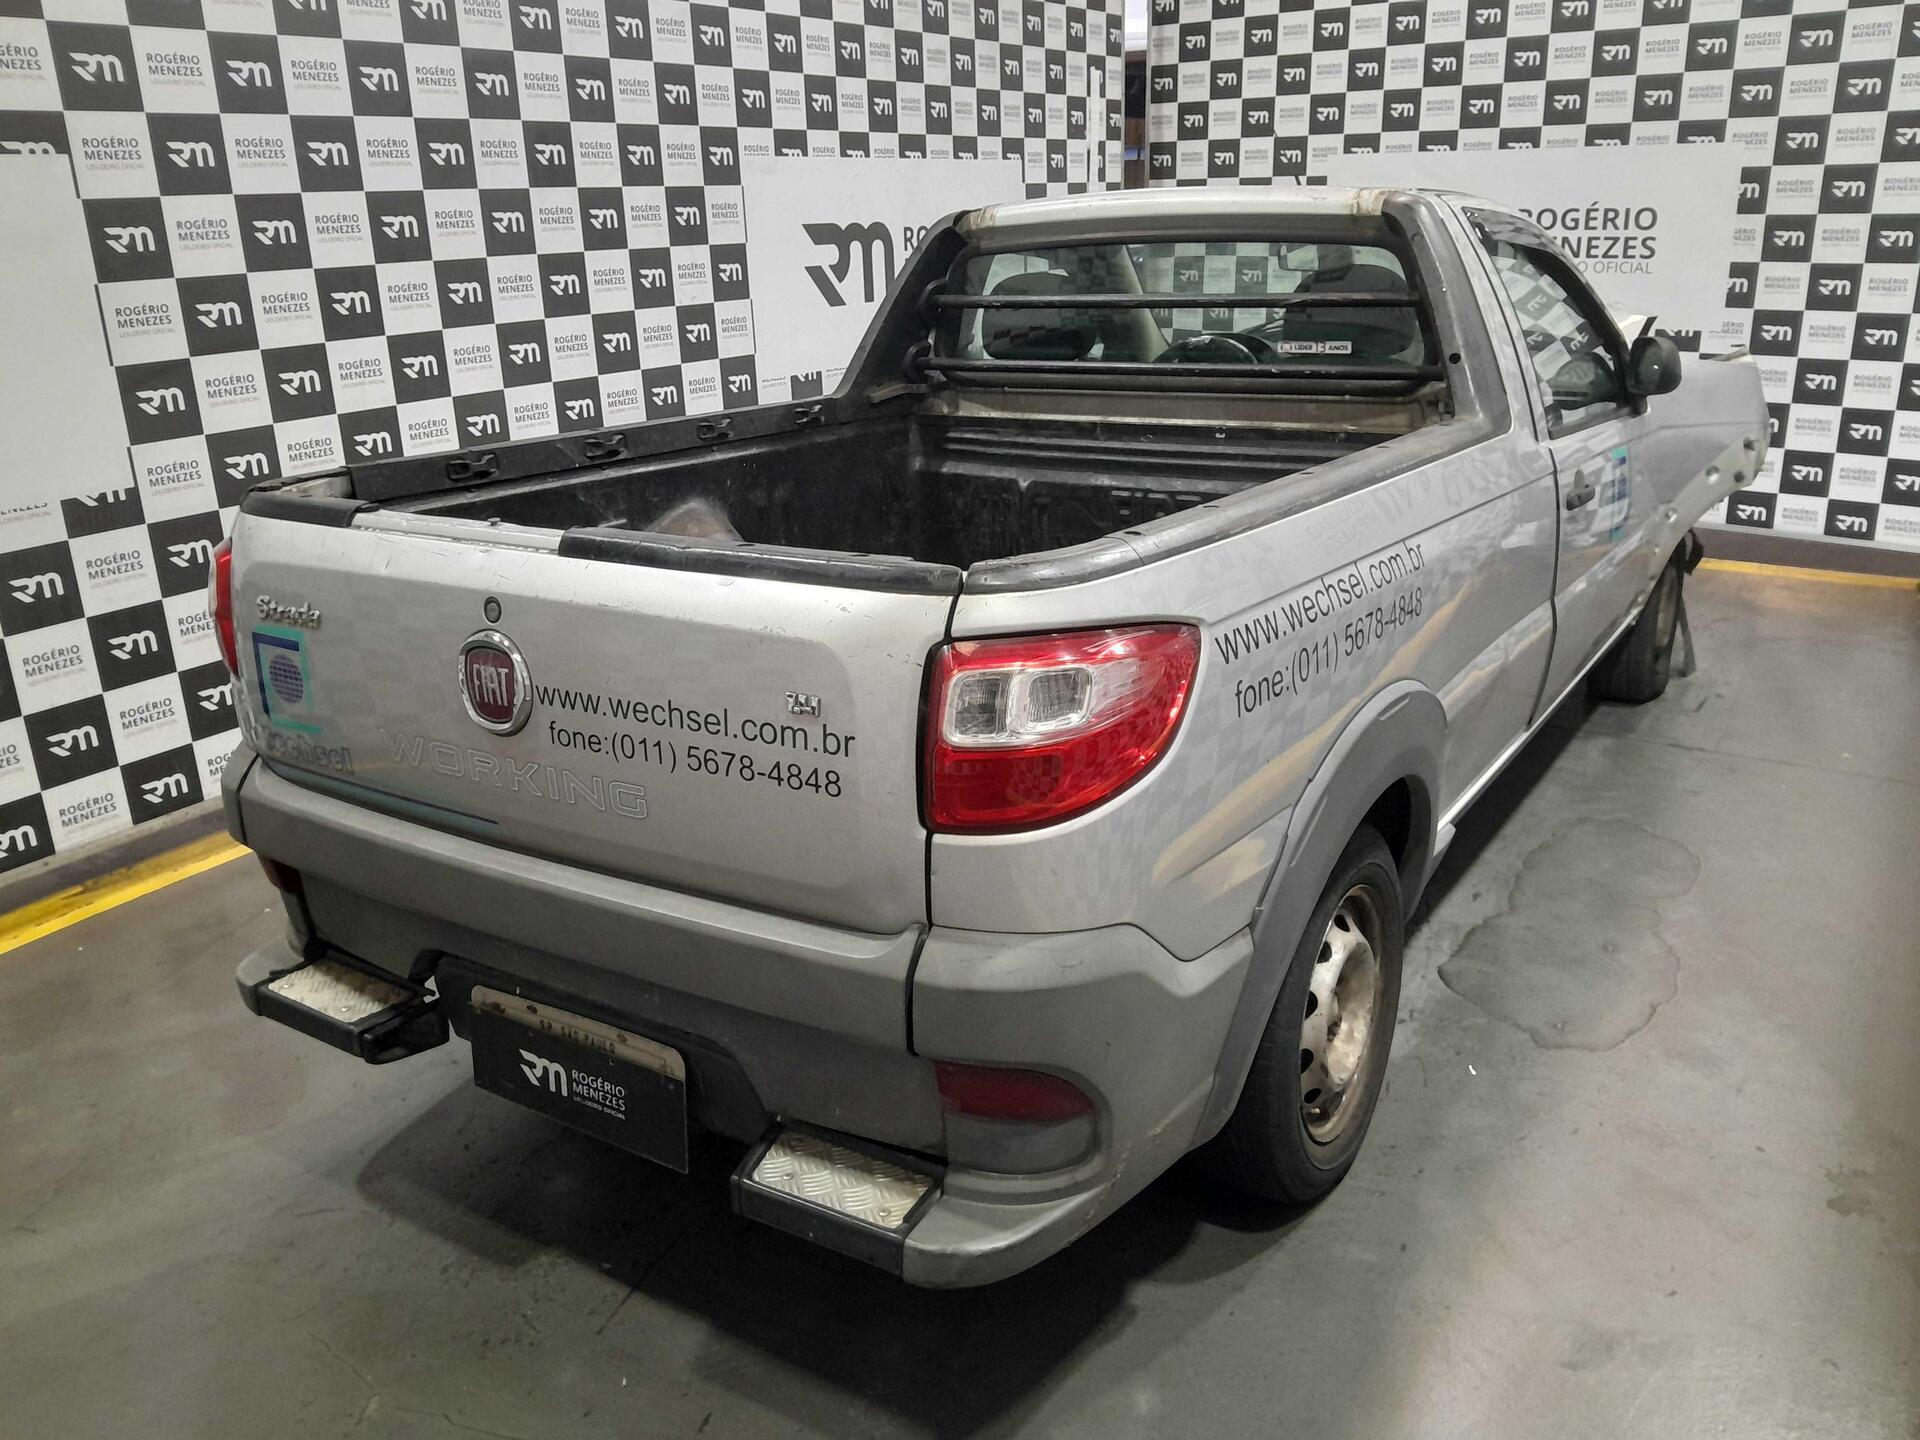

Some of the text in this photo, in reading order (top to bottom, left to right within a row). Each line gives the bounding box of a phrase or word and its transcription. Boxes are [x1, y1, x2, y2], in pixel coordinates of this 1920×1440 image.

[566, 17, 601, 29] MENEZES
[655, 27, 687, 38] MENEZES
[145, 51, 201, 65] ROGÉRIO
[290, 58, 338, 71] ROGÉRIO
[147, 64, 204, 78] MENEZES
[292, 71, 340, 83] MENEZES
[414, 64, 456, 77] ROGÉRIO
[416, 76, 458, 88] MENEZES
[524, 82, 561, 93] MENEZES
[618, 86, 651, 97] MENEZES
[701, 92, 731, 102] MENEZES
[81, 135, 140, 148] ROGÉRIO
[234, 135, 284, 148] ROGÉRIO
[365, 136, 409, 148] ROGÉRIO
[479, 138, 518, 149] ROGÉRIO
[83, 149, 143, 161] MENEZES
[236, 149, 287, 160] MENEZES
[367, 149, 411, 160] MENEZES
[480, 149, 519, 160] MENEZES
[579, 150, 614, 160] MENEZES
[666, 151, 697, 161] MENEZES
[314, 211, 360, 225] ROGÉRIO
[434, 207, 474, 220] ROGÉRIO
[630, 213, 663, 223] MENEZES
[711, 210, 742, 220] MENEZES
[1518, 201, 1658, 231] OGÉRIO
[175, 216, 228, 230] ROGÉRIO
[435, 219, 476, 230] MENEZES
[539, 216, 575, 226] MENEZES
[177, 230, 231, 242] MENEZES
[316, 224, 362, 236] MENEZES
[1593, 261, 1653, 274] OFICIAL
[496, 273, 536, 285] ROGÉRIO
[593, 276, 627, 287] MENEZES
[677, 270, 707, 281] MENEZES
[384, 281, 429, 294] ROGÉRIO
[497, 282, 537, 295] MENEZES
[260, 290, 309, 304] ROGÉRIO
[388, 292, 431, 304] MENEZES
[114, 302, 170, 318] ROGÉRIO
[262, 302, 311, 316] MENEZES
[116, 314, 173, 329] MENEZES
[721, 323, 752, 334] MENEZES
[642, 332, 674, 343] MENEZES
[452, 343, 491, 356] ROGÉRIO
[554, 341, 591, 354] MENEZES
[337, 357, 382, 372] ROGÉRIO
[454, 353, 493, 367] MENEZES
[204, 373, 255, 388] ROGÉRIO
[338, 367, 384, 382] MENEZES
[206, 383, 258, 400] MENEZES
[688, 384, 718, 396] MENEZES
[513, 401, 552, 415] ROGÉRIO
[607, 395, 641, 409] MENEZES
[512, 409, 552, 424] MENEZES
[407, 417, 448, 432] ROGÉRIO
[409, 427, 450, 441] MENEZES
[286, 436, 333, 453] ROGÉRIO
[288, 447, 335, 463] MENEZES
[146, 459, 199, 477] ROGÉRIO
[148, 470, 202, 488] MENEZES
[85, 549, 141, 569] ROGÉRIO
[87, 560, 144, 581] MENEZES
[1214, 539, 1426, 665] www.wechsel.com.br
[256, 595, 321, 629] Strada
[21, 644, 81, 667] ROGÉRIO
[1234, 587, 1424, 718] fone:(011) 5678-4848
[24, 655, 84, 679] MENEZES
[472, 663, 511, 708] FIAT
[119, 697, 173, 720] ROGÉRIO
[121, 707, 176, 731] MENEZES
[536, 684, 856, 757] www.wechsel.com.br
[549, 721, 842, 797] fone:(011) 5678-4848
[380, 725, 648, 820] WORKING
[58, 792, 114, 818] ROGÉRIO
[60, 802, 118, 829] MENEZES
[571, 1069, 625, 1097] ROGÉRIO
[572, 1081, 626, 1111] MENEZES
